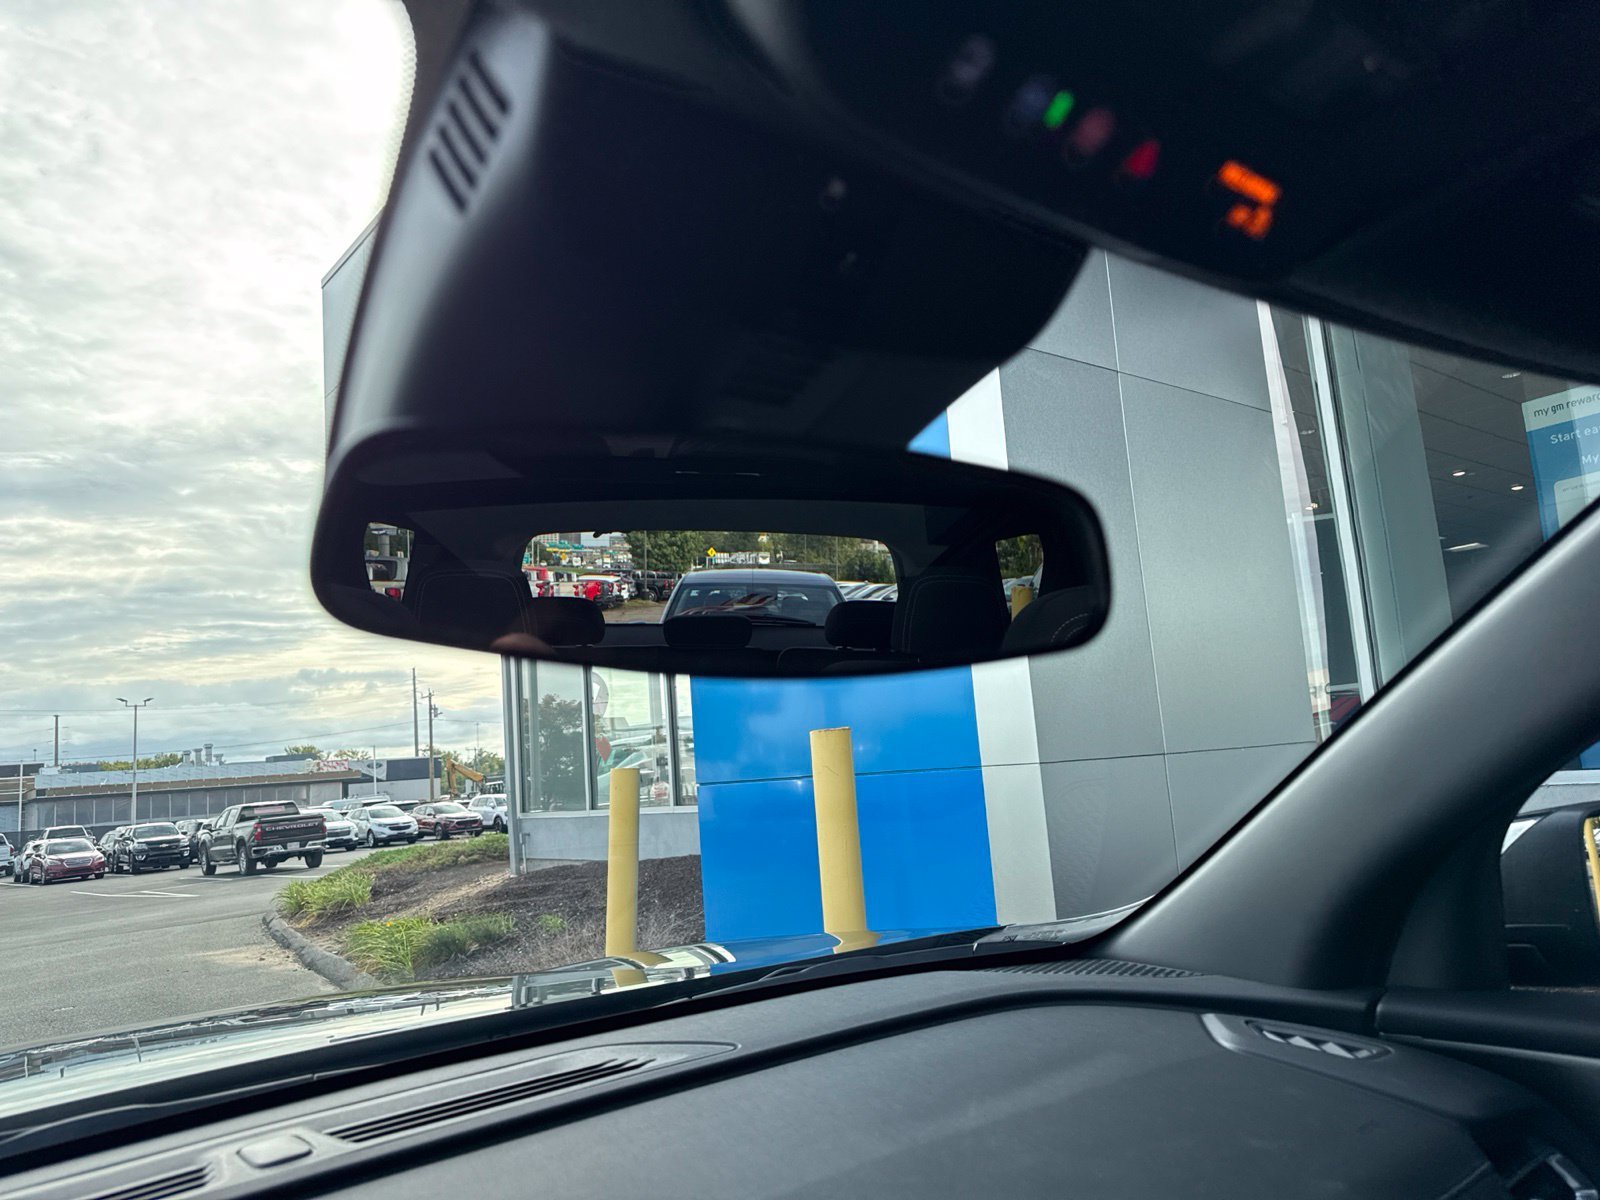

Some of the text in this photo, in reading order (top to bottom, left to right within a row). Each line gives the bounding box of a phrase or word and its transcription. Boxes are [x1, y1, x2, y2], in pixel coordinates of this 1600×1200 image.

[1533, 407, 1549, 417] my
[1550, 403, 1565, 415] gm
[1550, 425, 1600, 444] Start ea
[265, 822, 319, 831] CHEVROLET
